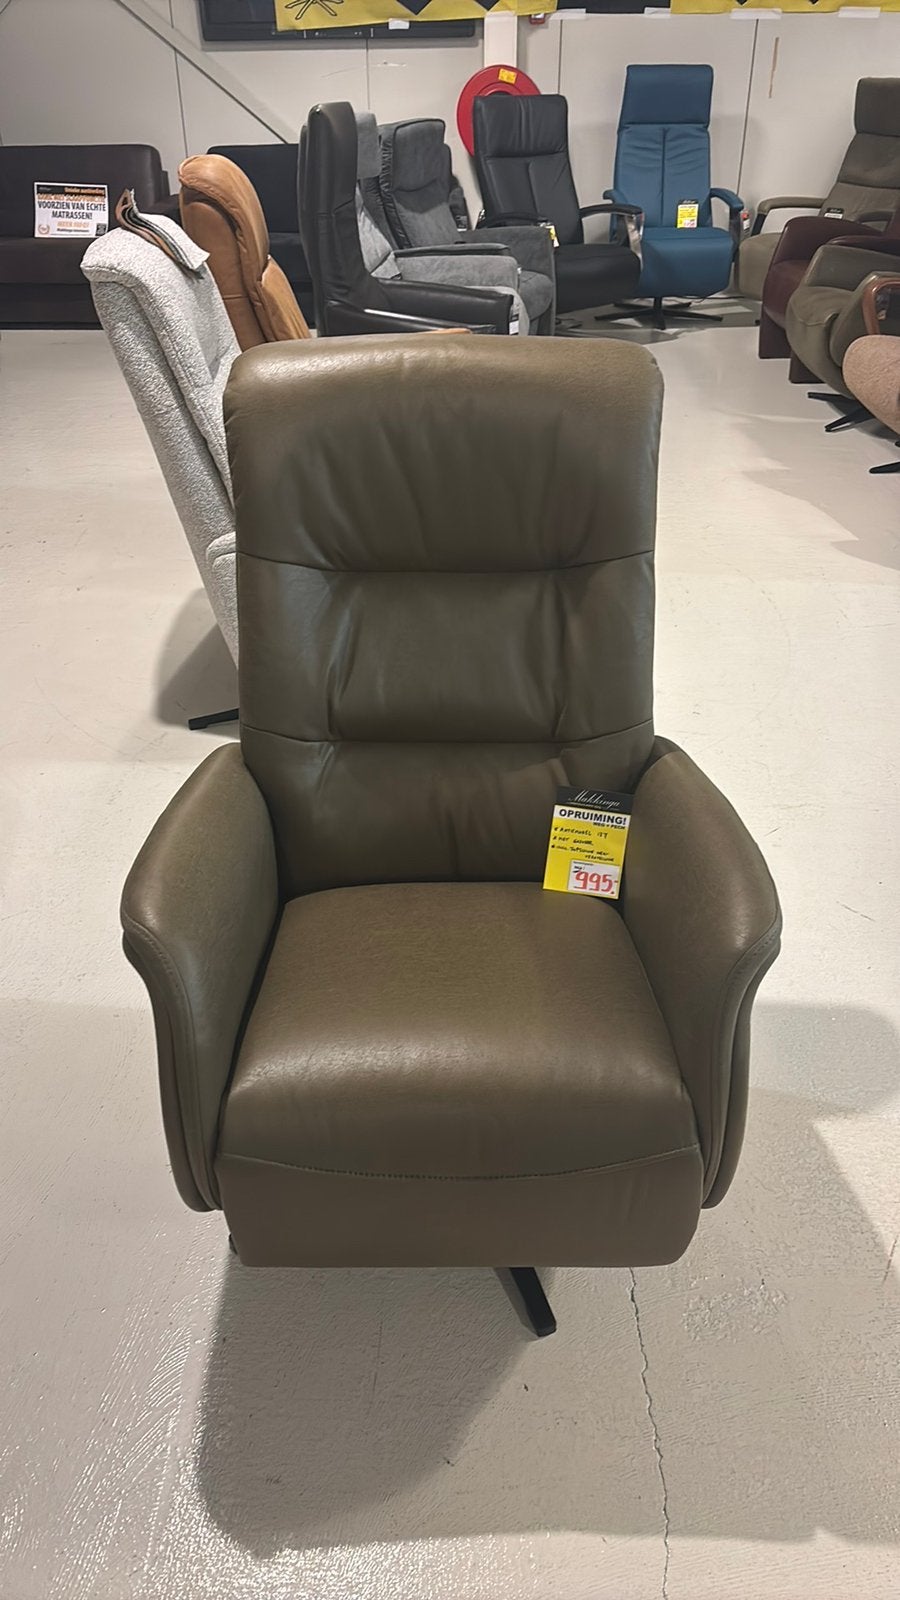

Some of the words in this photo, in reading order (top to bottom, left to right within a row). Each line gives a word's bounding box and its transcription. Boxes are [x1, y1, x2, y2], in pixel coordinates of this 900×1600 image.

[37, 201, 70, 209] VOORZIEN
[71, 202, 85, 211] VAN
[86, 203, 106, 212] ECHTE
[51, 210, 93, 220] MATRASSEN!
[559, 808, 627, 826] OPRUIMING!
